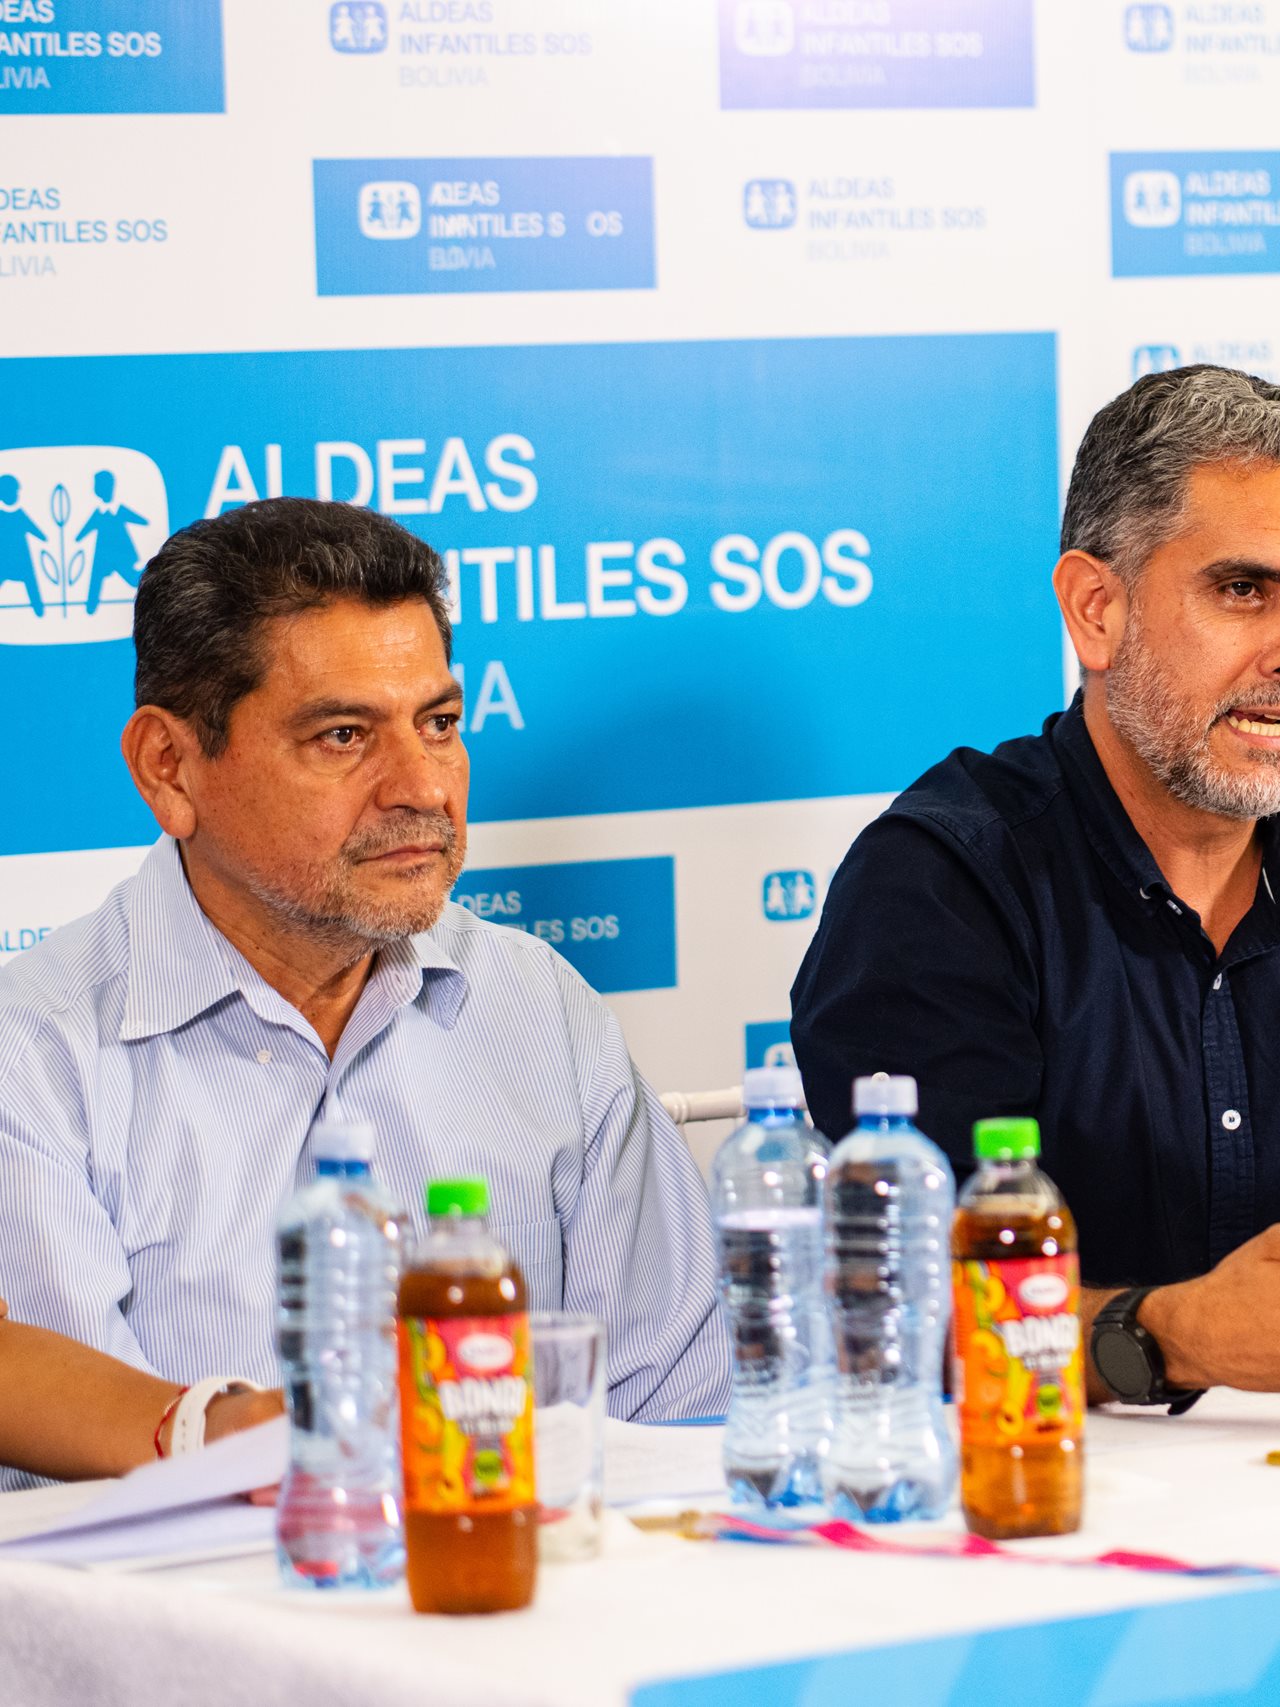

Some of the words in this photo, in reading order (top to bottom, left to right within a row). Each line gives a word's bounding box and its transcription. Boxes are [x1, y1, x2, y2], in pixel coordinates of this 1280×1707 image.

[0, 32, 102, 57] ANTILES
[107, 32, 162, 57] SOS
[400, 33, 537, 56] INFANTILES
[544, 33, 594, 56] SOS
[0, 220, 108, 243] ANTILES
[116, 219, 168, 243] SOS
[709, 527, 875, 613] SOS
[456, 891, 522, 917] DEAS
[570, 914, 620, 940] SOS
